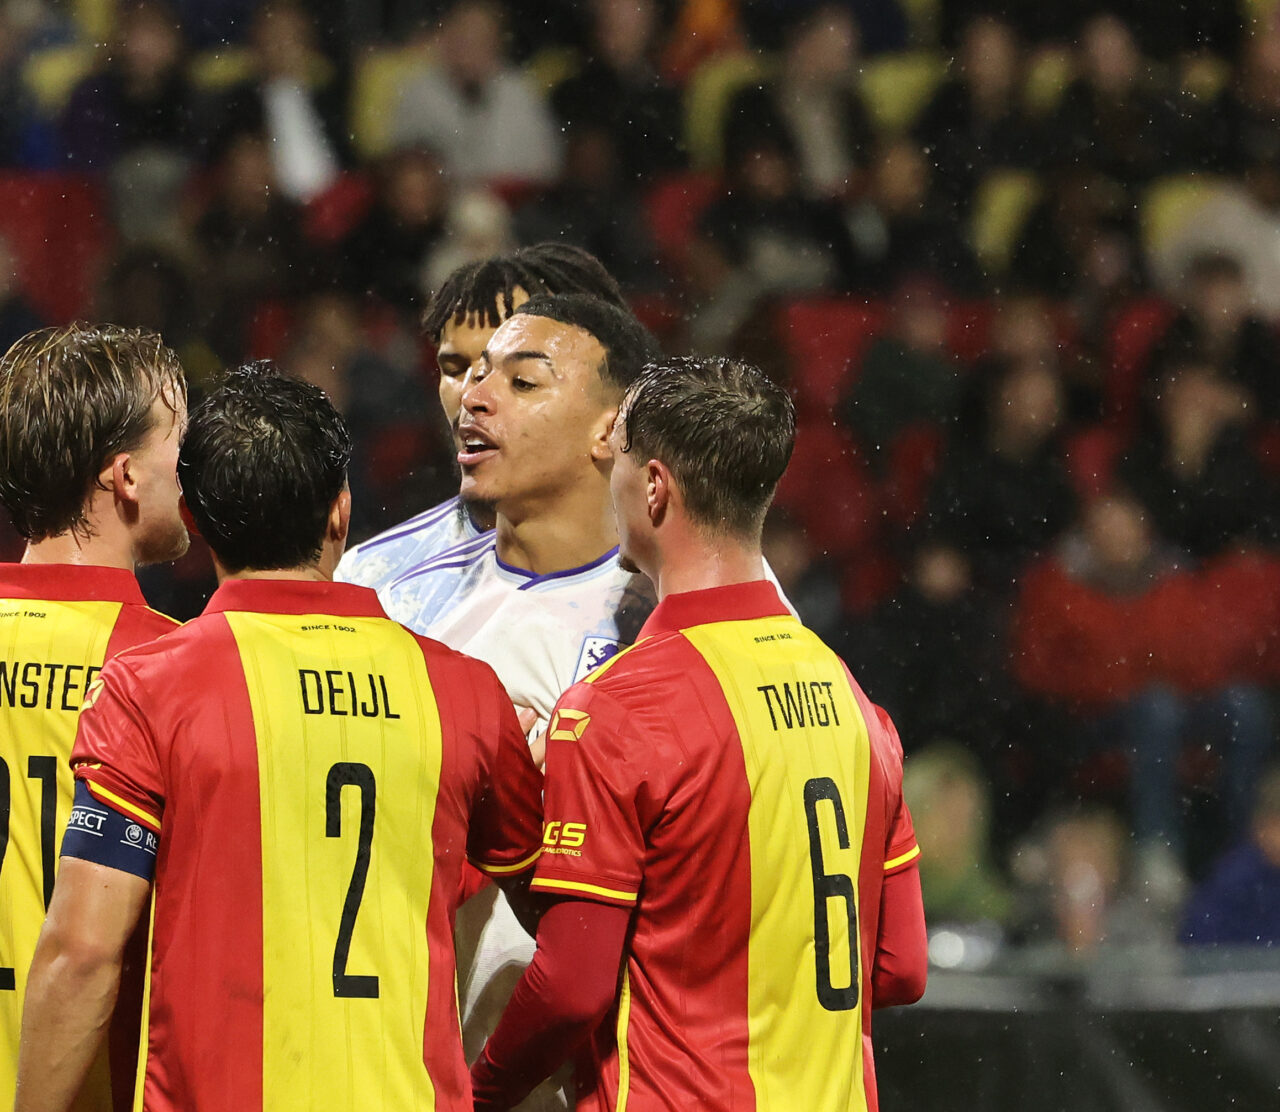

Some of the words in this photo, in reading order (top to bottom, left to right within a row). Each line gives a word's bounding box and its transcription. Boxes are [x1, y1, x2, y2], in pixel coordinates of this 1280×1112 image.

[23, 610, 47, 619] 1902
[301, 624, 330, 632] SINCE
[333, 624, 357, 633] 1902
[298, 669, 401, 720] DEIJL
[757, 681, 840, 732] TWIGT
[325, 762, 380, 999] 2
[803, 776, 860, 1012] 6
